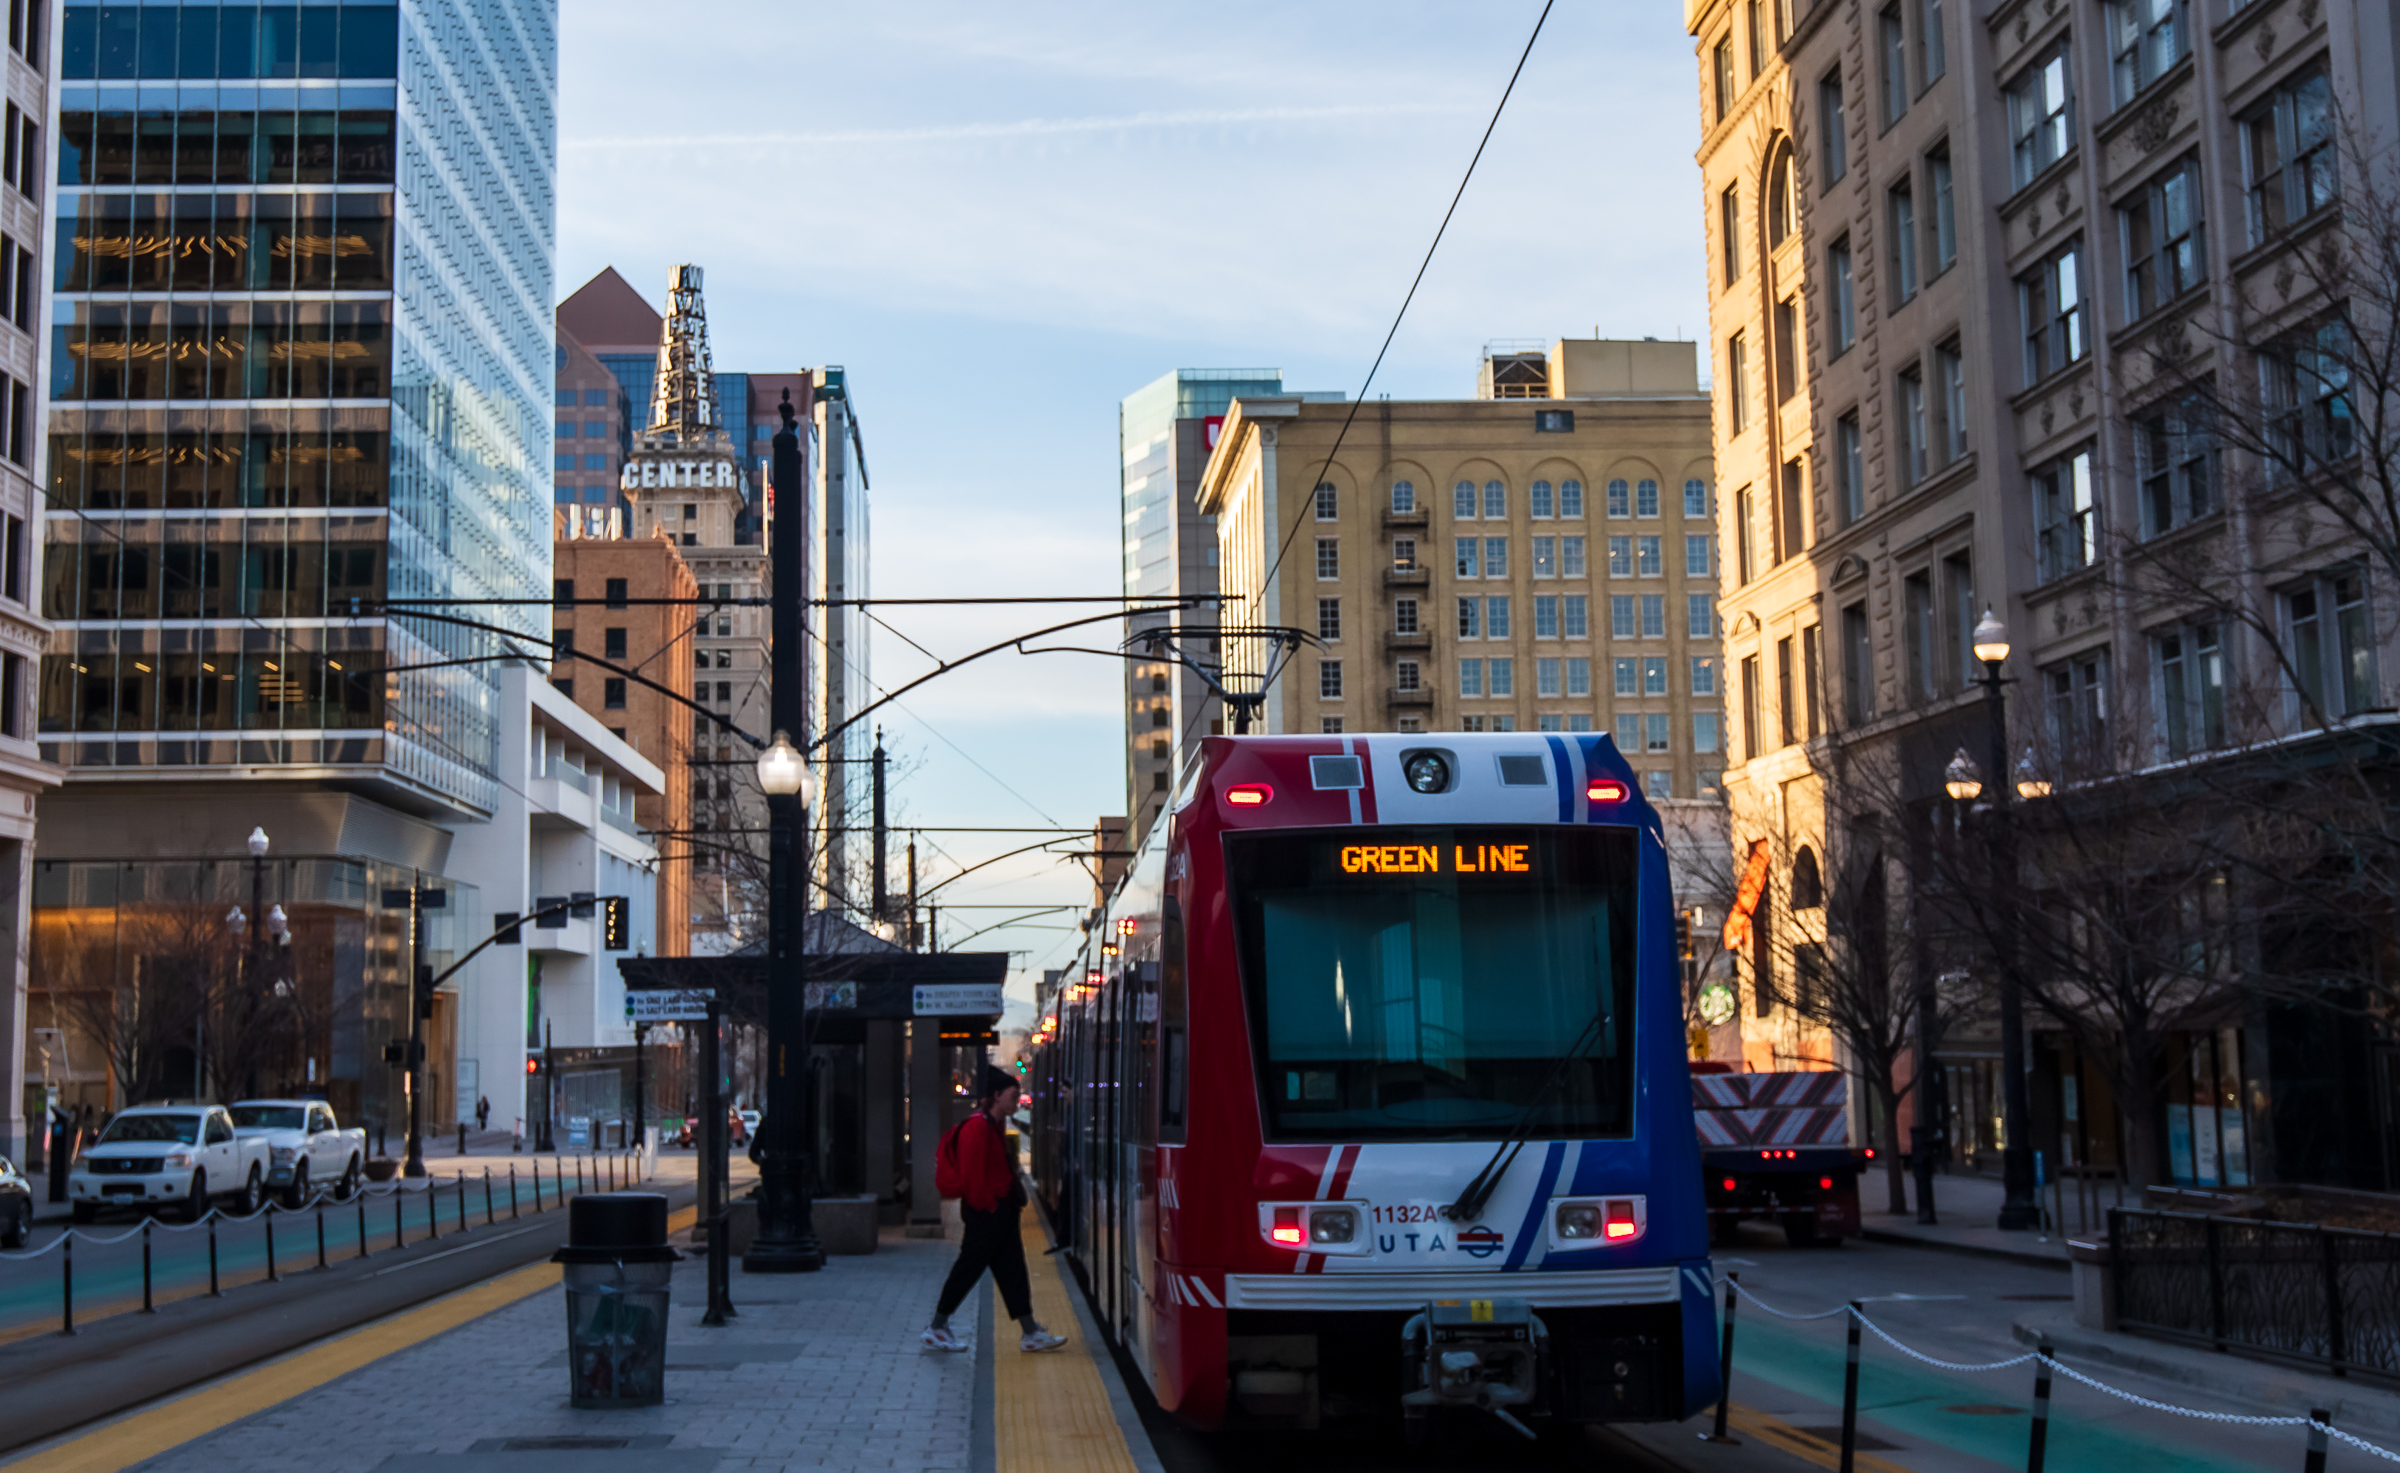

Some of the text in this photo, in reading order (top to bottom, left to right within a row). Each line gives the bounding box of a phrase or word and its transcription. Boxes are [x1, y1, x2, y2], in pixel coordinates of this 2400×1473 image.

[655, 264, 681, 426] WALKER
[688, 265, 711, 426] WALKER
[623, 462, 733, 488] CENTER
[1341, 845, 1529, 873] GREEN LINE
[1373, 1205, 1438, 1223] 1132A
[1379, 1234, 1446, 1254] UTA
